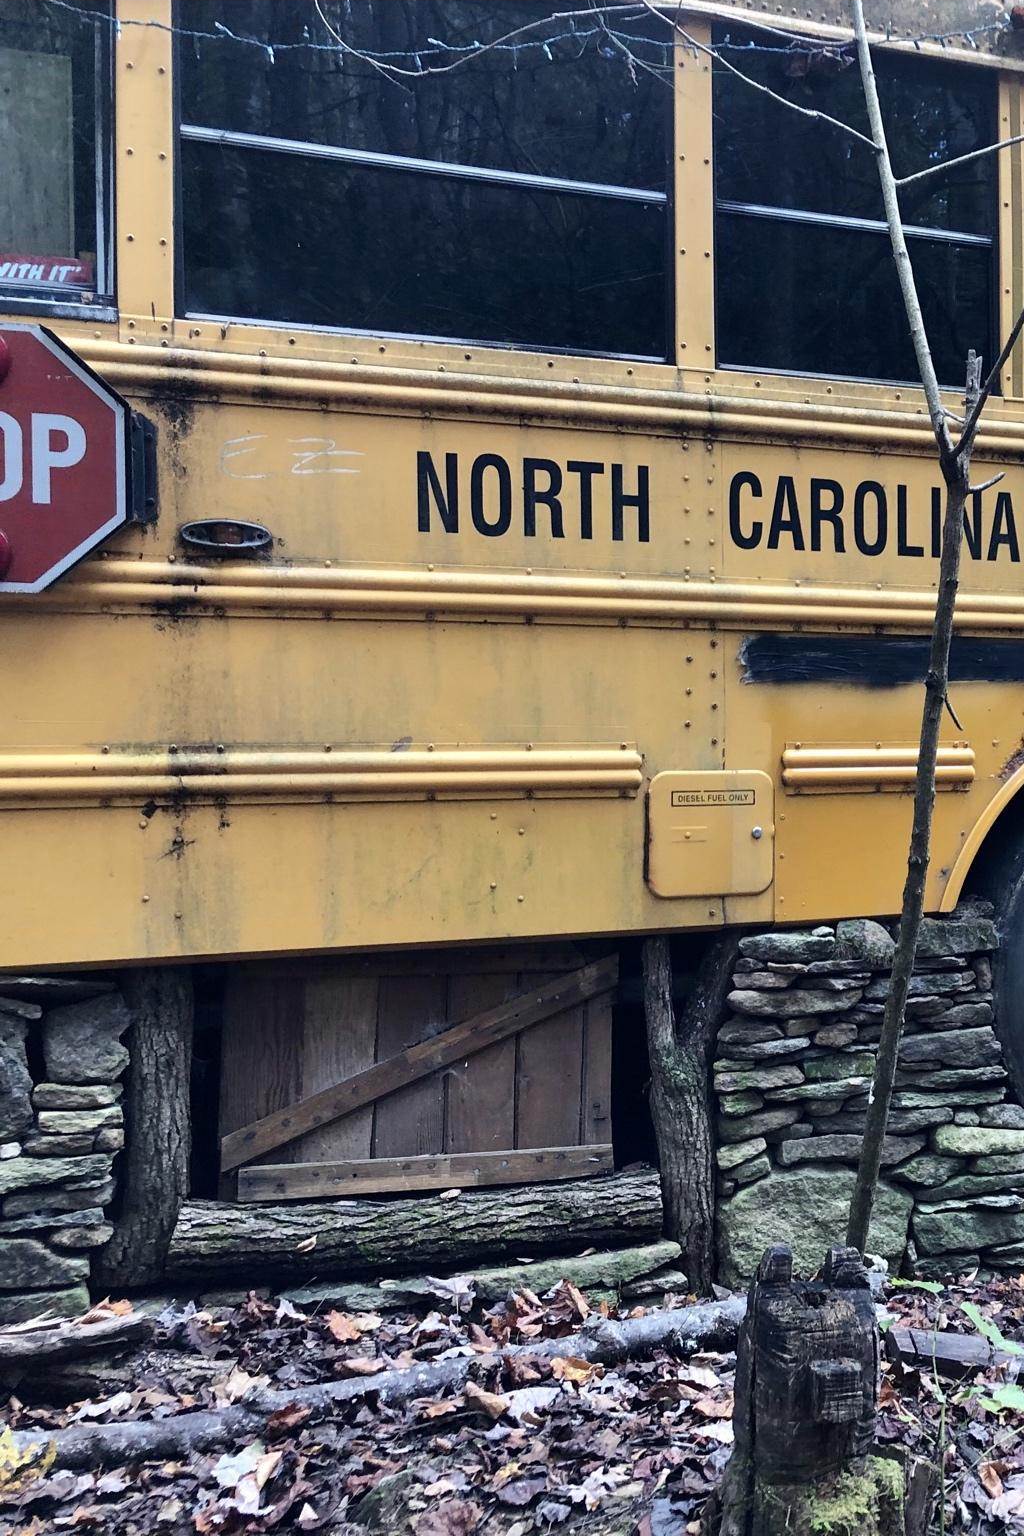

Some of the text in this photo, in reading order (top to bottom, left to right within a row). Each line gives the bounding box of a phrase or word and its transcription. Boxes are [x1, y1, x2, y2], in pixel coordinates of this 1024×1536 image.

[416, 450, 650, 543] NORTH
[728, 470, 1021, 563] CAROLINA
[677, 793, 749, 803] DIESEL FUEL ONLY
